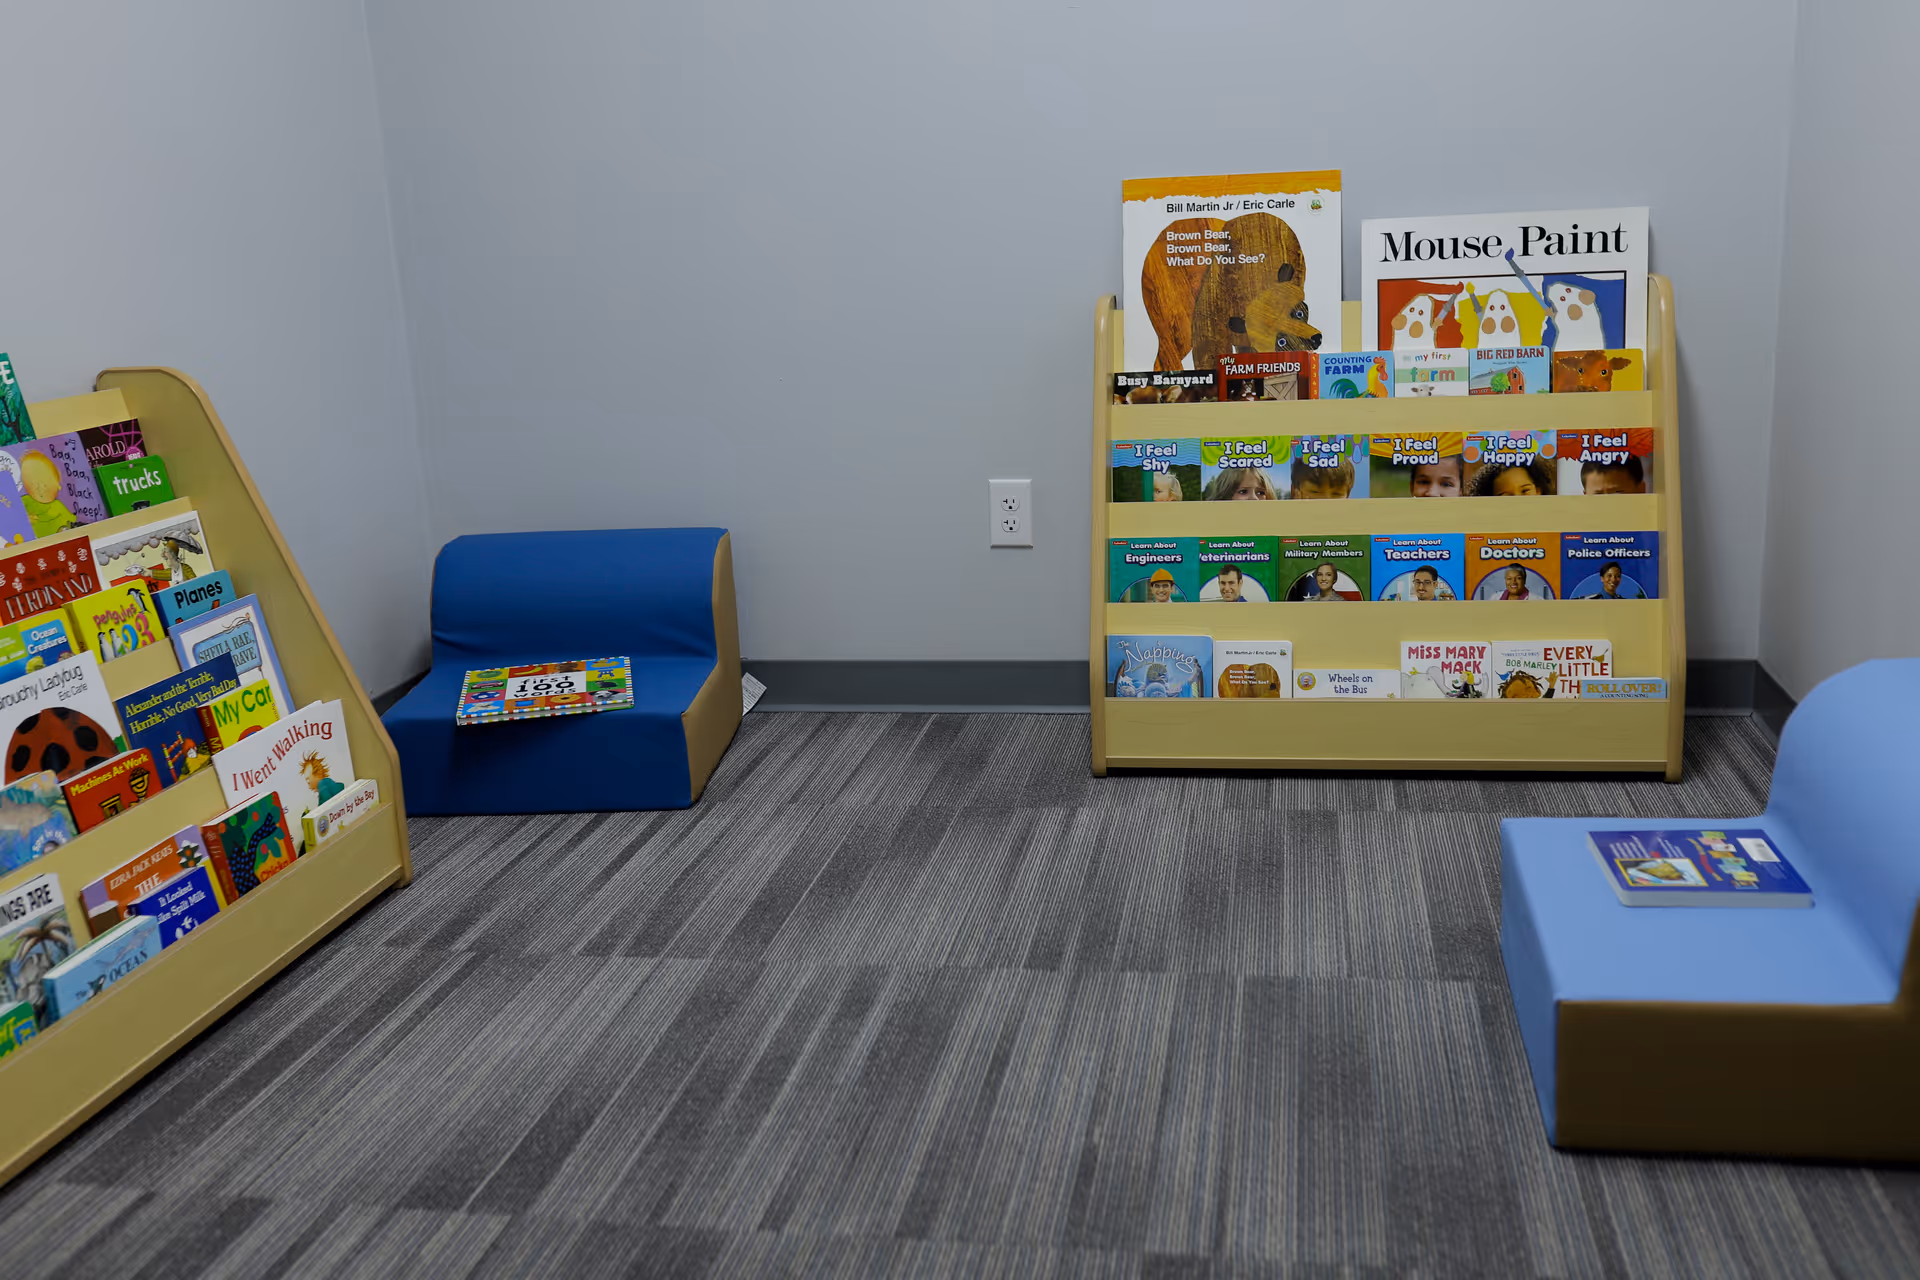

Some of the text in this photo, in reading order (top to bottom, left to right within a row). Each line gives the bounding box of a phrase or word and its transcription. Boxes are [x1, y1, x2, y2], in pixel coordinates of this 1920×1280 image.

[1167, 203, 1183, 213] Bill
[1186, 202, 1220, 213] Martin
[1223, 201, 1234, 212] Jr
[1243, 200, 1264, 210] Eric
[1267, 199, 1295, 209] Carle
[1167, 230, 1231, 241] Brown Bear,
[1379, 222, 1628, 262] Mouse Paint
[1167, 242, 1231, 254] Brown Bear,
[1167, 254, 1265, 267] What Do You See?
[1220, 356, 1235, 366] My
[1324, 356, 1372, 365] COUNTING
[1415, 354, 1428, 363] my
[1432, 352, 1451, 361] first
[1476, 348, 1544, 360] BIG RED BARN
[1226, 362, 1301, 375] FARM FRIENDS
[1325, 365, 1364, 375] FARM
[1410, 367, 1455, 382] farm
[1118, 374, 1213, 389] Busy Barnyard
[1224, 441, 1266, 454] I Feel
[1302, 440, 1345, 453] I Feel
[1394, 438, 1437, 451] I Feel
[1487, 436, 1531, 449] I Feel
[1582, 434, 1627, 447] I Feel
[1135, 444, 1177, 457] I Feel
[1580, 450, 1629, 464] Angry
[1219, 455, 1272, 468] Scared
[1309, 455, 1338, 467] Sad
[1393, 452, 1438, 465] Proud
[1484, 451, 1534, 466] Happy
[1142, 459, 1170, 474] Shy
[113, 468, 162, 495] trucks
[67, 484, 93, 500] Black
[73, 502, 102, 517] Sheep!
[1126, 554, 1182, 565] Engineers
[1285, 549, 1363, 558] Military Members
[1385, 548, 1450, 560] Teachers
[1480, 547, 1545, 559] Doctors
[1568, 548, 1650, 558] Police Officers
[174, 581, 223, 609] Planes
[93, 603, 137, 630] penguins
[31, 627, 58, 642] Ocean
[28, 636, 67, 655] Creatures
[199, 631, 255, 664] SHEILA RAE,
[233, 647, 257, 667] RAVE
[1124, 642, 1195, 674] Napping
[1446, 646, 1487, 660] MARY
[1544, 646, 1593, 661] EVERY
[1441, 661, 1482, 675] MACK
[1506, 659, 1557, 671] BOB MARLEY
[39, 666, 83, 692] Ladybug
[521, 676, 571, 684] first
[1328, 674, 1359, 683] Wheels
[514, 688, 576, 698] words
[516, 682, 575, 693] 100
[1334, 685, 1367, 694] the Bus
[1587, 683, 1662, 694] ROLL OVER!
[58, 692, 71, 701] Eric
[164, 706, 176, 720] No
[195, 691, 212, 706] Very
[210, 682, 225, 697] Bad
[224, 678, 237, 691] Day
[125, 694, 162, 718] Alexander
[213, 700, 240, 728] My
[241, 684, 272, 713] Car
[232, 720, 333, 791] I Went Walking
[70, 754, 149, 797] Machines At Work
[329, 789, 375, 824] Down by the Bay
[110, 844, 173, 891] EZRA JACK KEATS
[134, 873, 163, 896] THE
[27, 884, 52, 912] ARE
[165, 882, 194, 904] Looked
[109, 951, 148, 982] OCEAN
